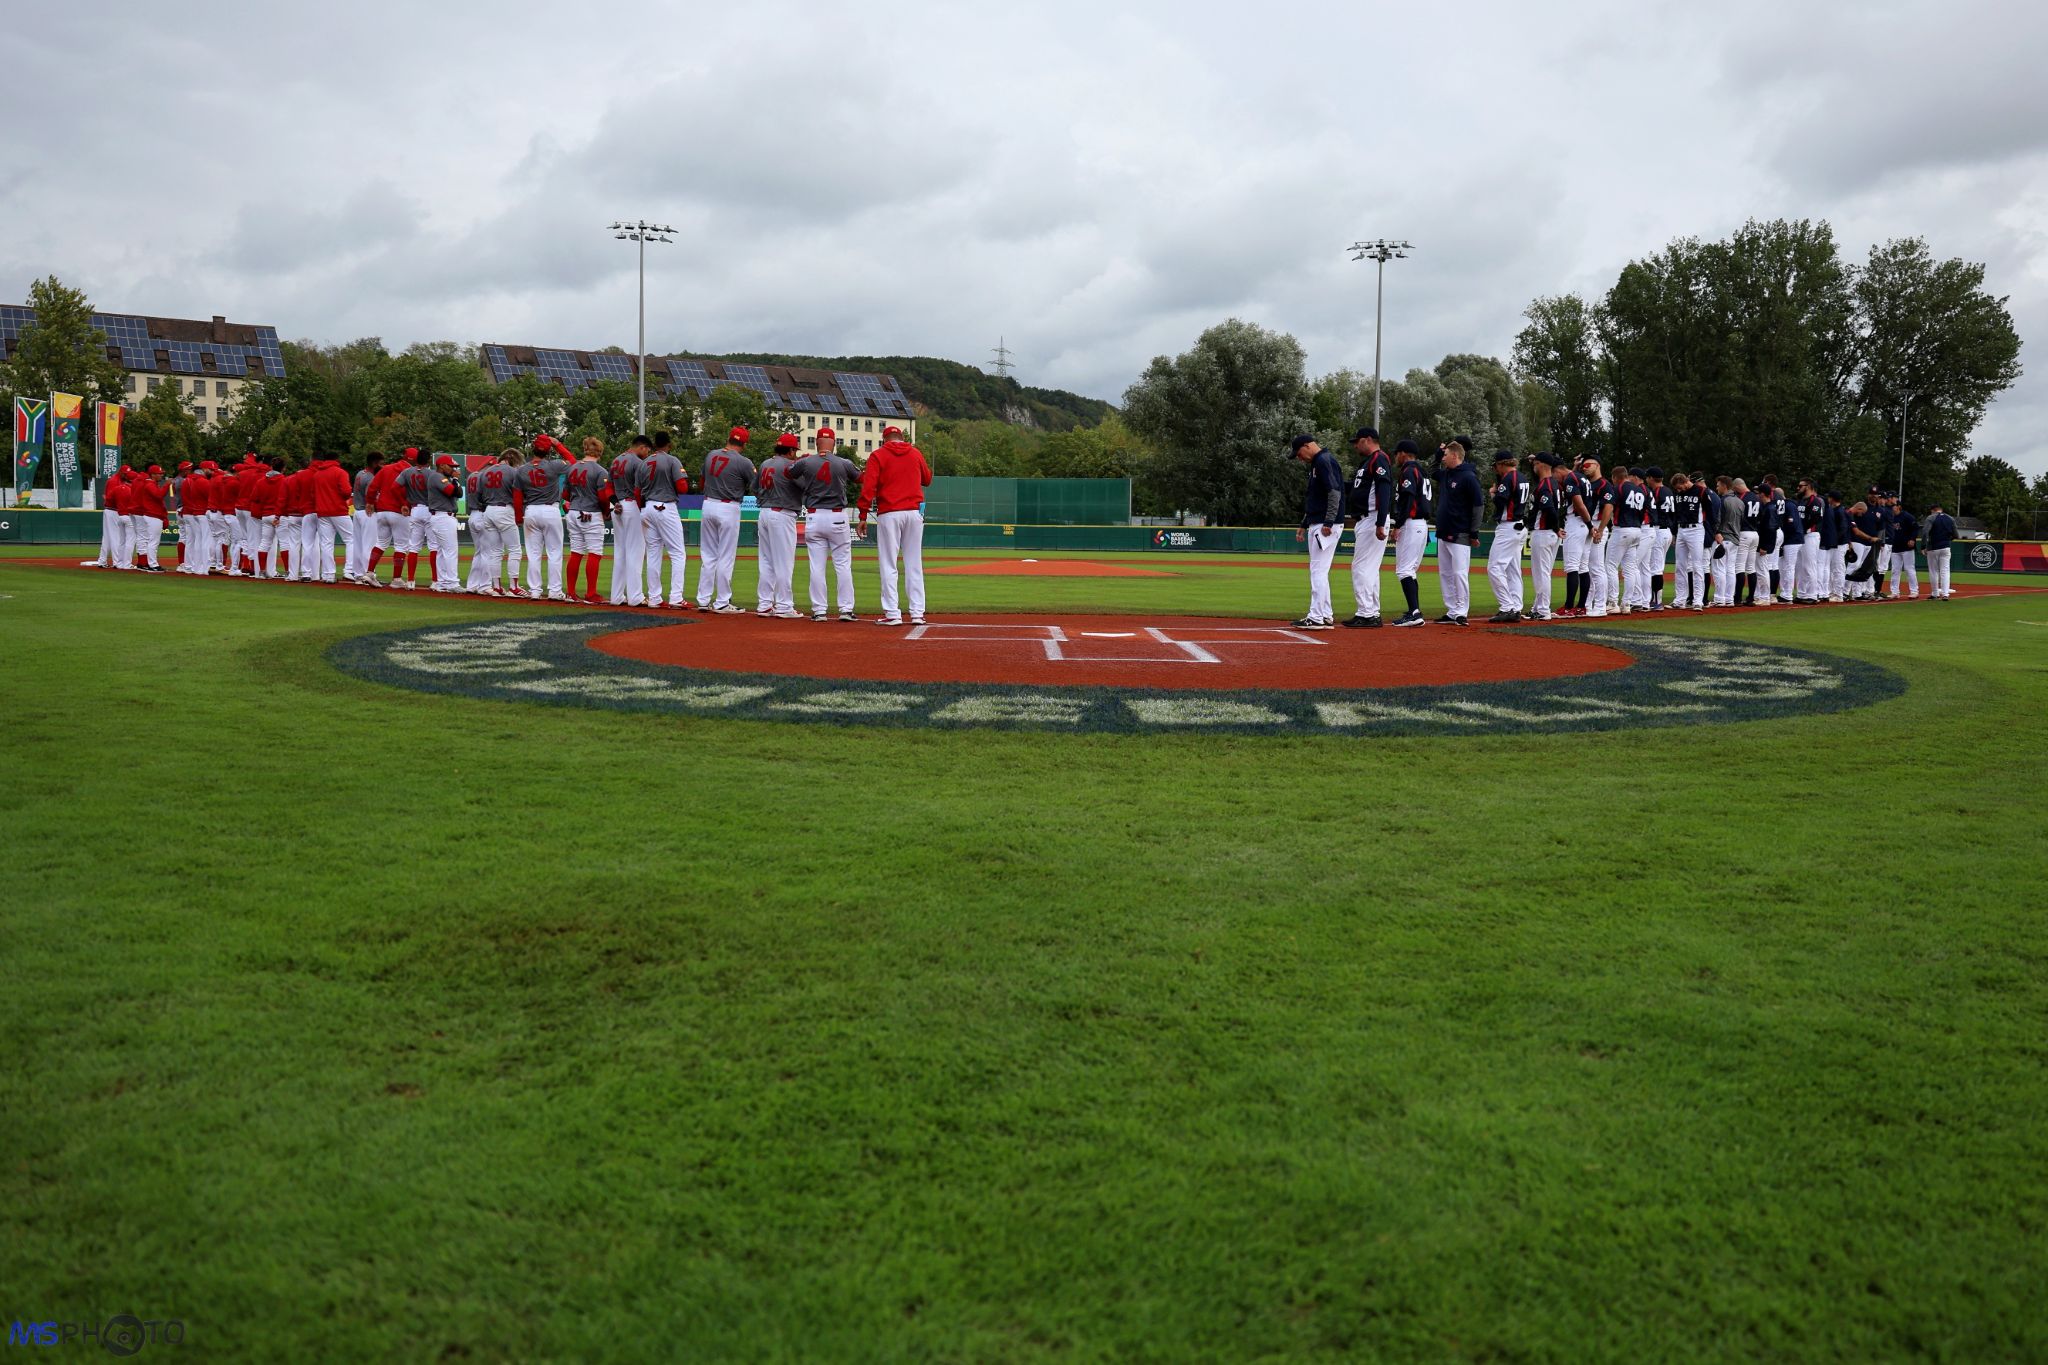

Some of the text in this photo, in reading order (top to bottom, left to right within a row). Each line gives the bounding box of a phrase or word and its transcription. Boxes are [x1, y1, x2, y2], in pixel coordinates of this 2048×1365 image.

[55, 442, 65, 476] CLASSIC
[61, 442, 72, 482] BASEBALL
[68, 442, 77, 471] WORLD
[610, 460, 627, 480] 24
[646, 460, 656, 480] 7
[709, 456, 729, 478] 17
[816, 460, 832, 486] 4
[484, 470, 502, 488] 38
[528, 468, 548, 488] 16
[568, 468, 588, 488] 44
[1626, 490, 1644, 510] 49
[1748, 501, 1760, 518] 14
